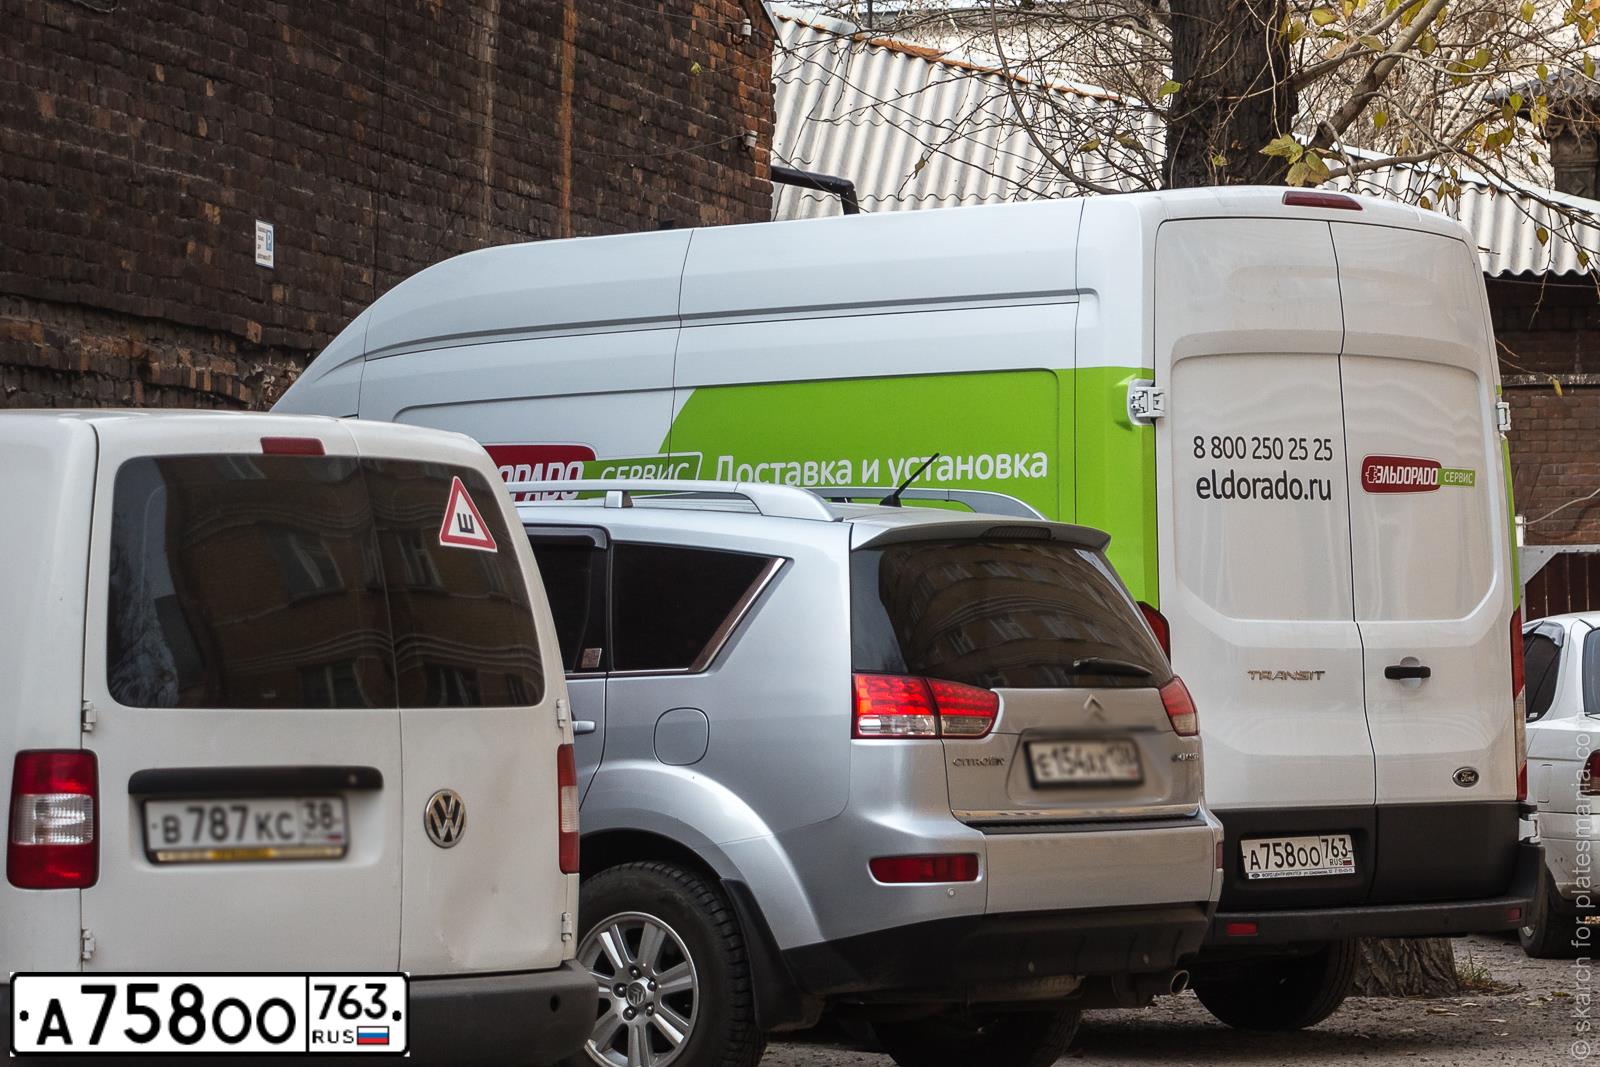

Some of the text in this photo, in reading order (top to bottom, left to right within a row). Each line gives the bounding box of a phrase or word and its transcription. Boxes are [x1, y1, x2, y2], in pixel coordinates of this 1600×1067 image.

[1193, 435, 1333, 461] 8 800 250 25 25
[715, 451, 1048, 488] Доставка и установка
[1444, 471, 1474, 484] СЕРВИС
[1196, 468, 1332, 501] eldorado.ru
[457, 512, 475, 534] Ш
[1247, 670, 1326, 681] TRANSIT
[1321, 838, 1348, 859] 763
[1329, 857, 1344, 866] RUS
